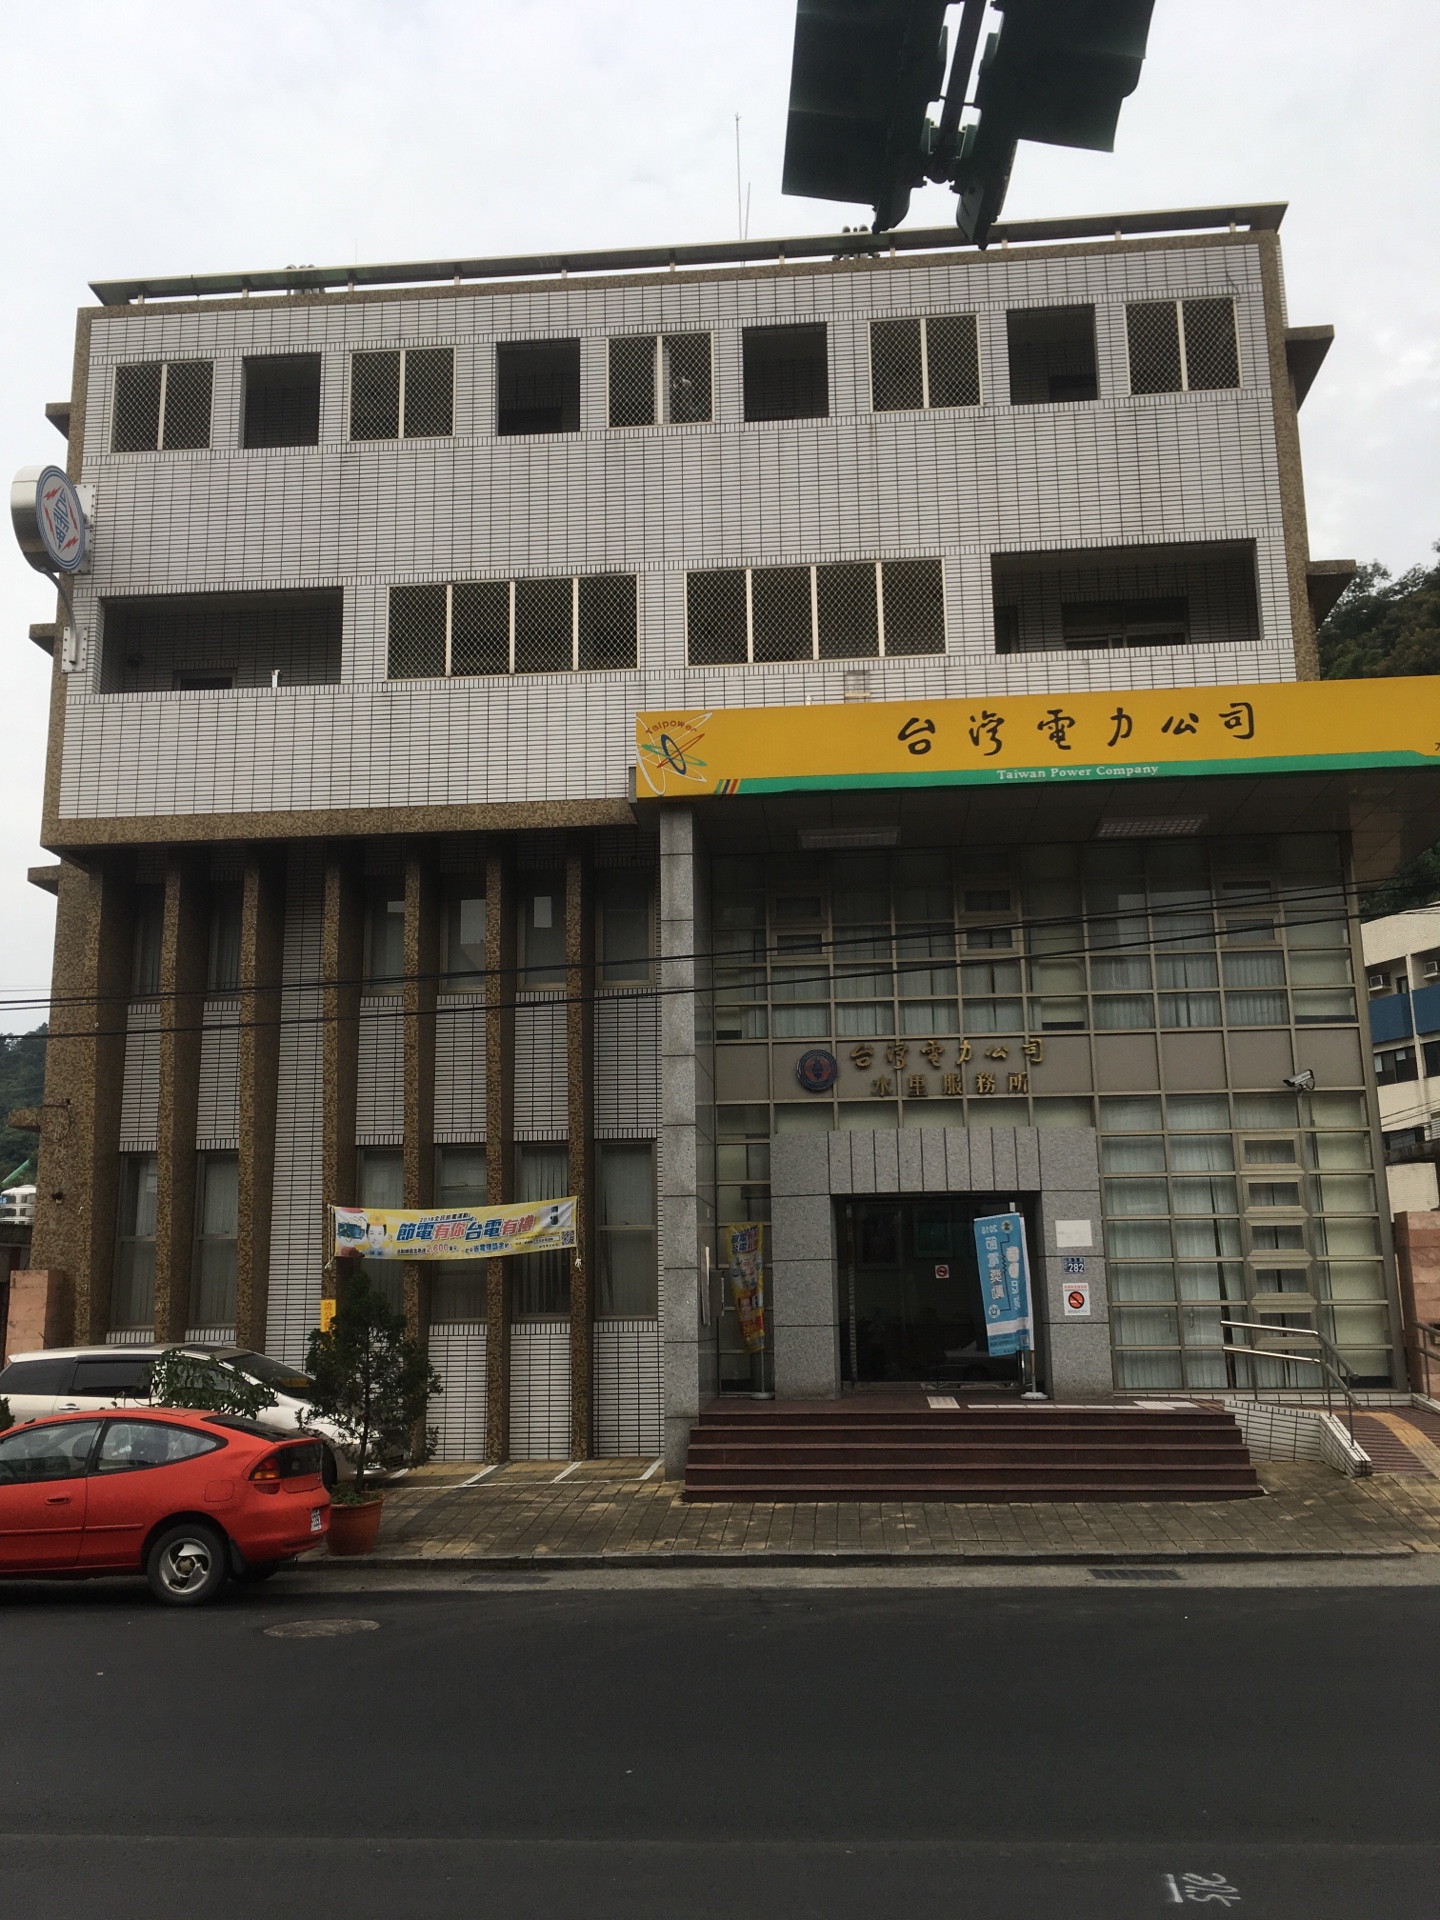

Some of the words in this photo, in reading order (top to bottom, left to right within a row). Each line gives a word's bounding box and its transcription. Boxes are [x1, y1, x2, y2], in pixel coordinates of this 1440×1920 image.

[645, 720, 698, 735] Taipower
[897, 702, 1256, 757] 台灣電力公司
[996, 768, 1047, 780] Taiwan
[1050, 767, 1094, 779] Power
[1096, 764, 1159, 779] Company
[850, 1038, 1045, 1070] 台灣電力公司
[870, 1071, 1030, 1098] 水里服務所
[396, 1214, 537, 1241] 節電有你台電有禮
[1068, 1263, 1084, 1272] 282
